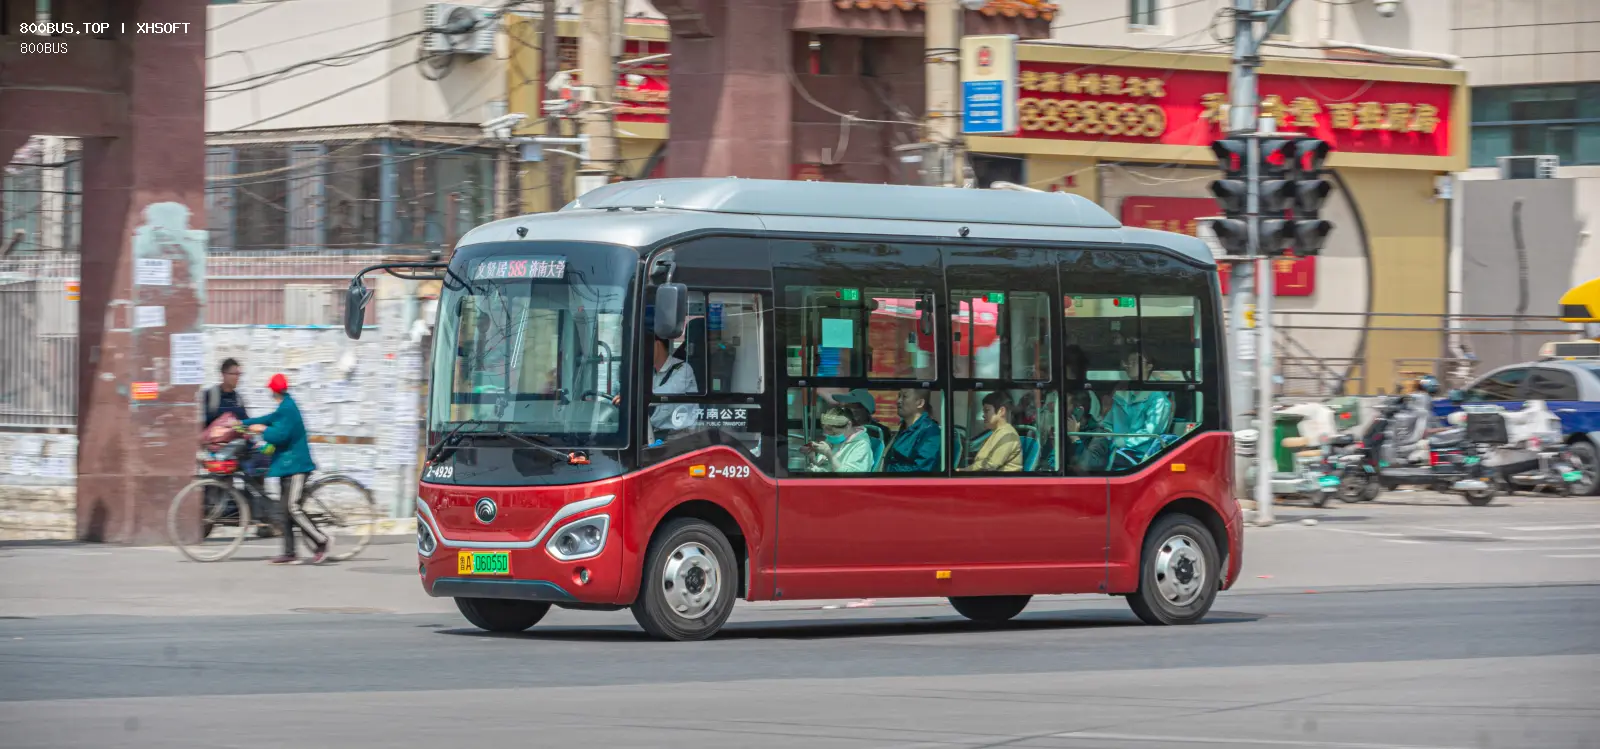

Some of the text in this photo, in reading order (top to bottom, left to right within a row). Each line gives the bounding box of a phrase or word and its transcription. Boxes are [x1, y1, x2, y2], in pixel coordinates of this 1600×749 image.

[508, 260, 528, 277] 585
[529, 260, 565, 278] 济南大学
[427, 465, 453, 478] 2-4929
[708, 465, 750, 478] 2-4929
